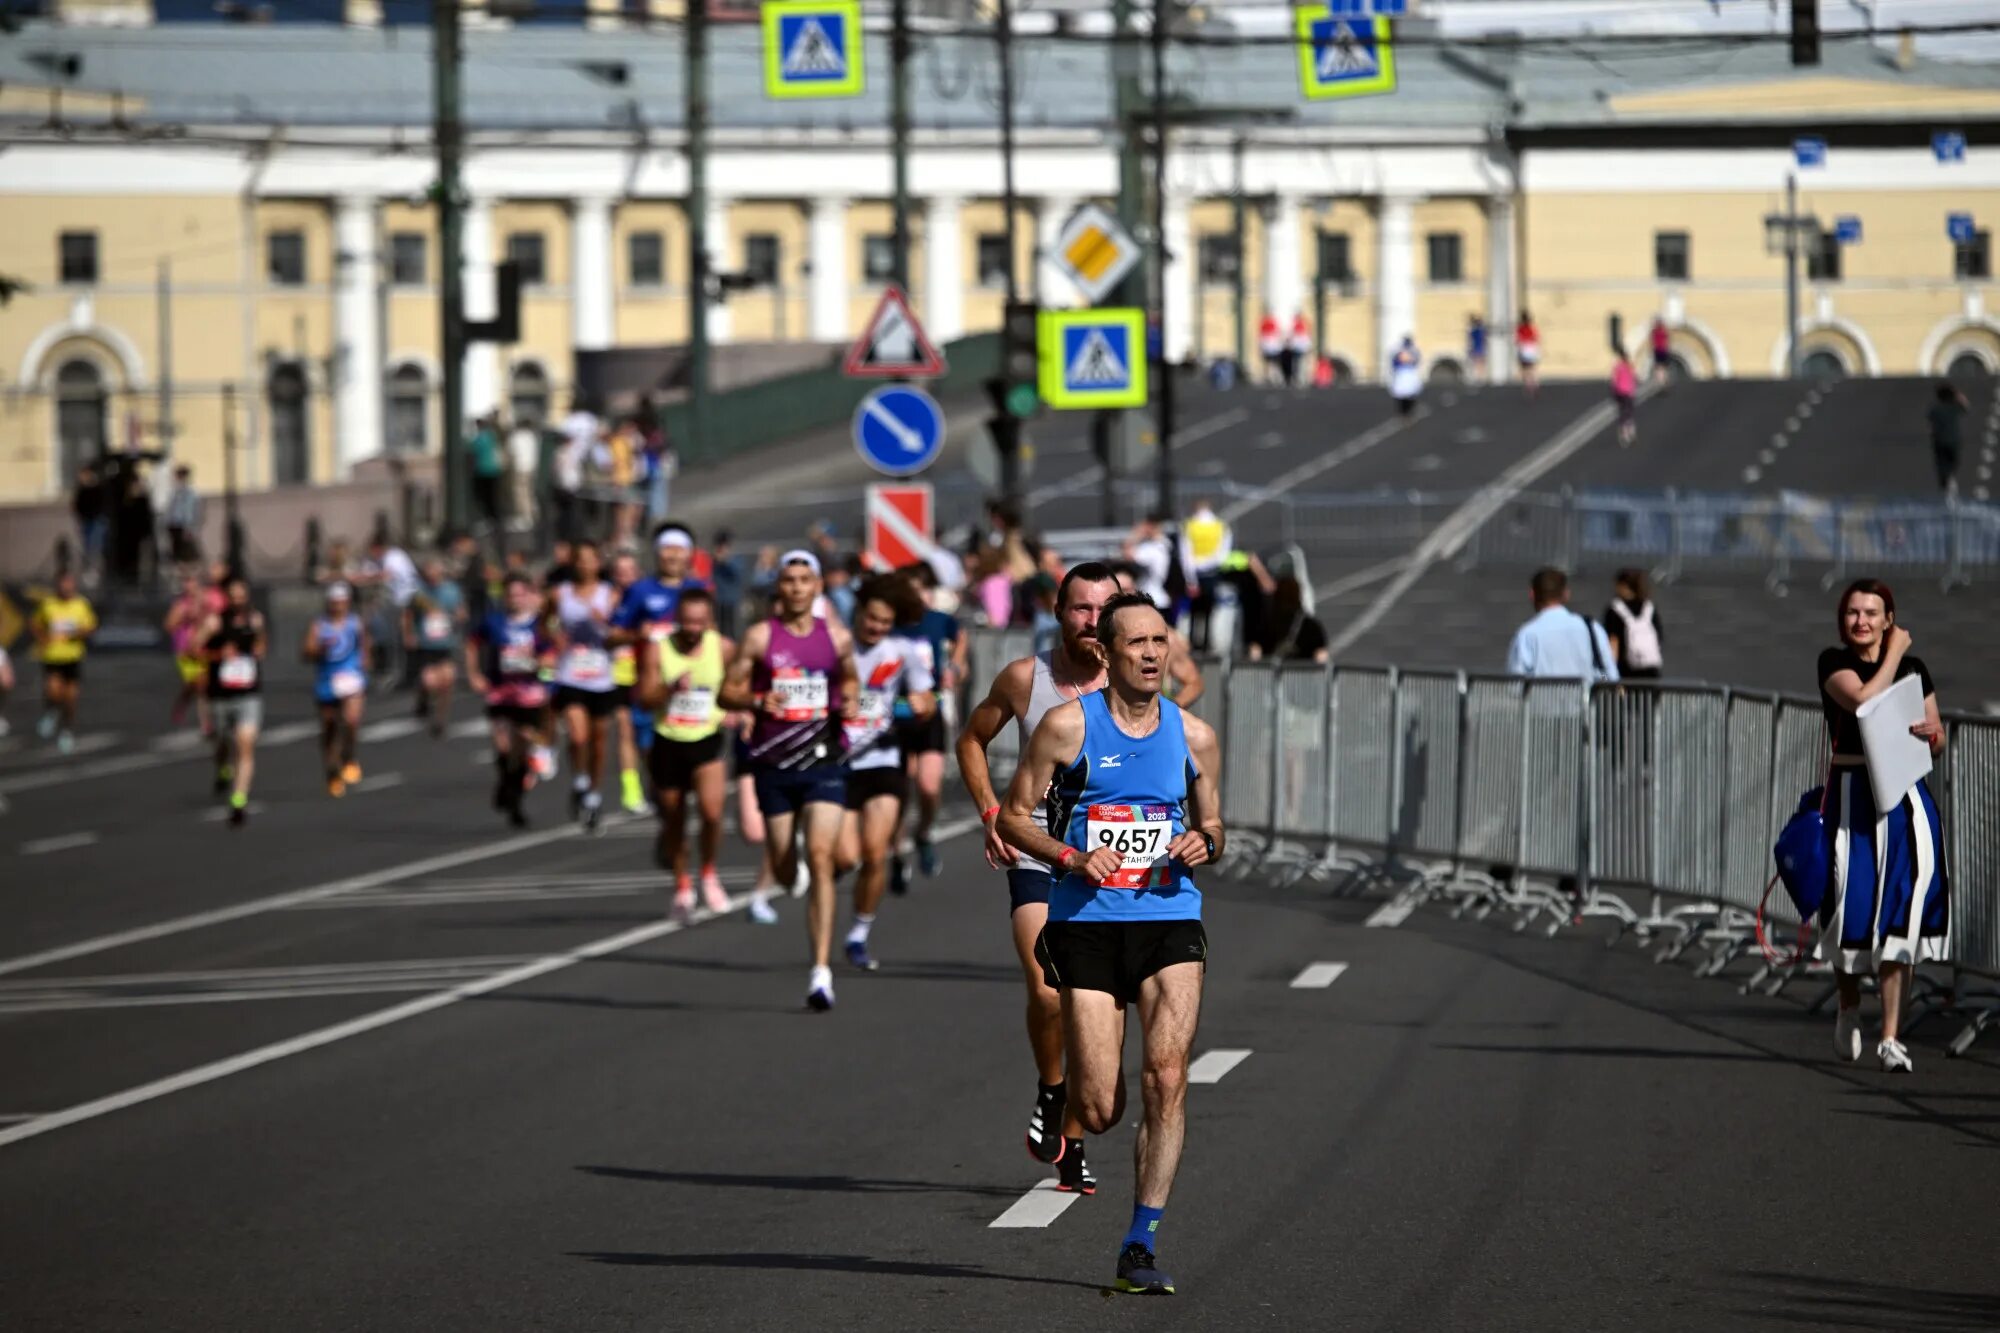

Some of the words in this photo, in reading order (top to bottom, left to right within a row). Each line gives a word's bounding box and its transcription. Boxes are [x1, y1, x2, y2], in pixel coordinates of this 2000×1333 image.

[1147, 813, 1167, 821] 2023
[1099, 829, 1161, 853] 9657
[1121, 856, 1154, 864] СТАНТИН
